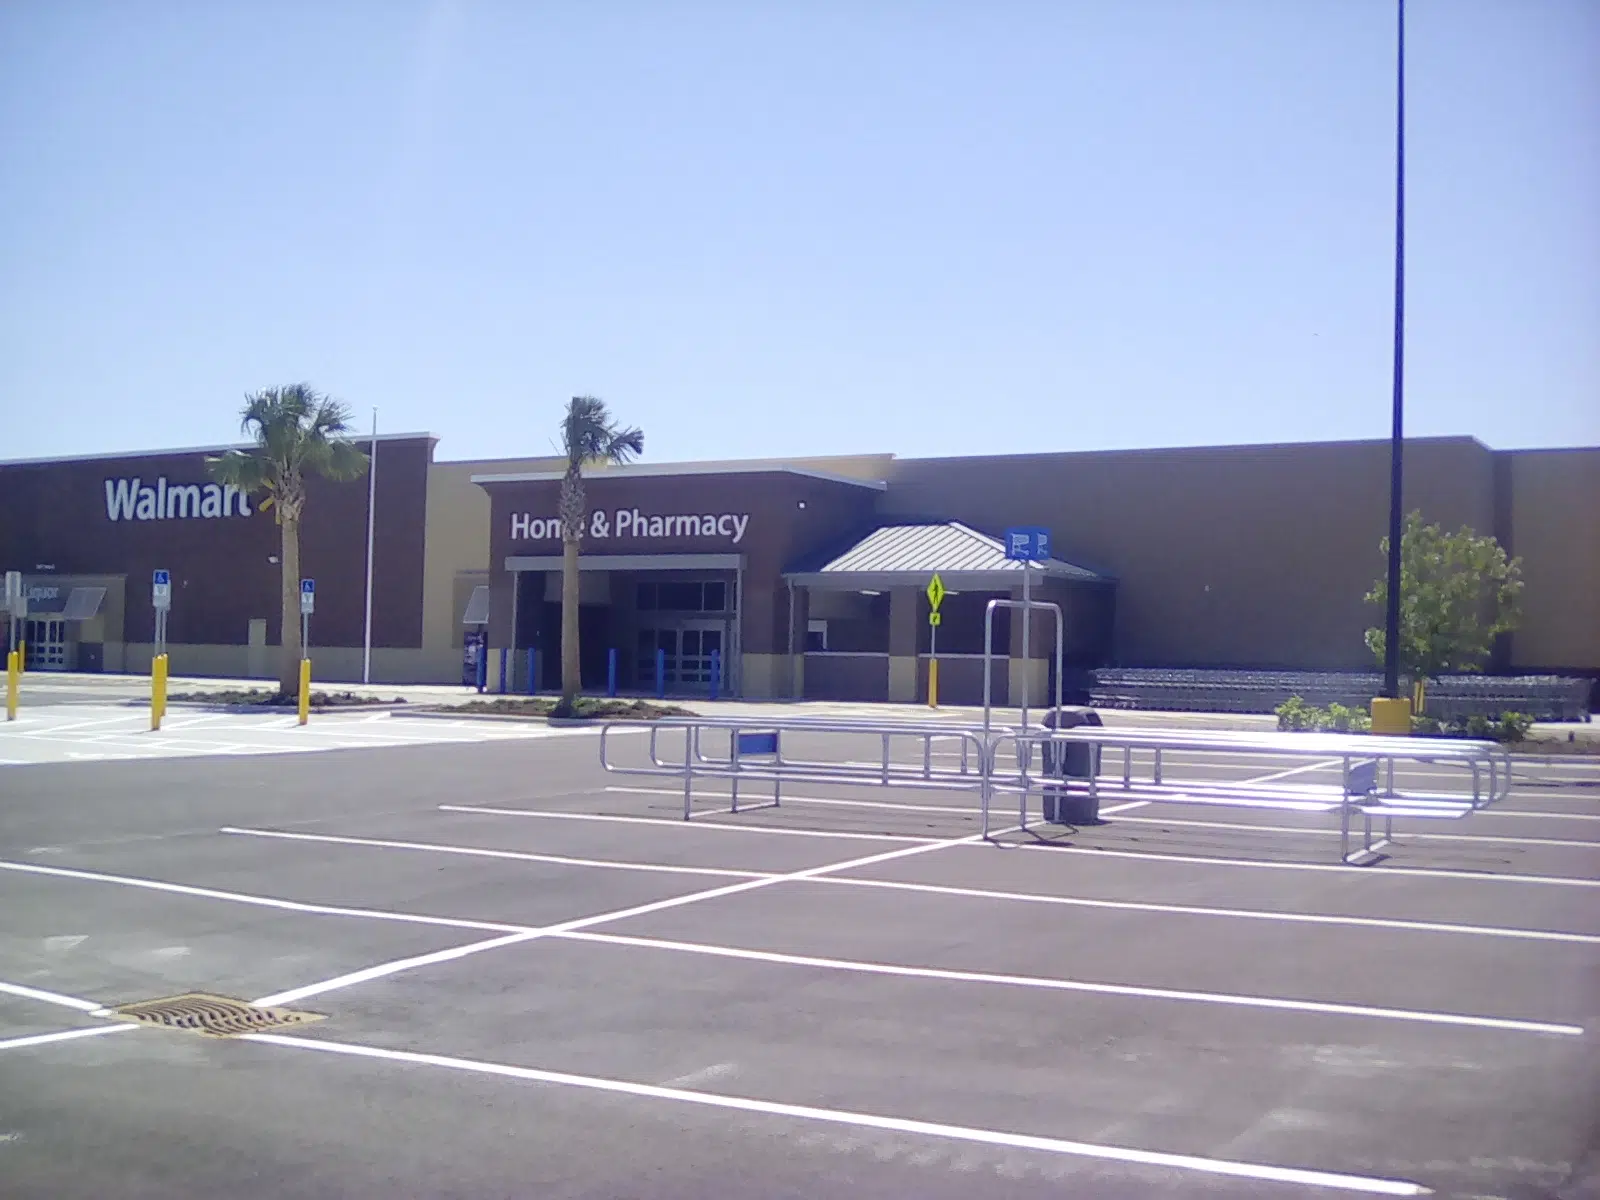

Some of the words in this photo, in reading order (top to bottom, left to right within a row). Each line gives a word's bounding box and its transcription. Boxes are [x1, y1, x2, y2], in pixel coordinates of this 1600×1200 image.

[105, 477, 252, 521] Walmart
[511, 513, 585, 540] Hom
[590, 510, 611, 538] &
[616, 508, 749, 544] Pharmacy
